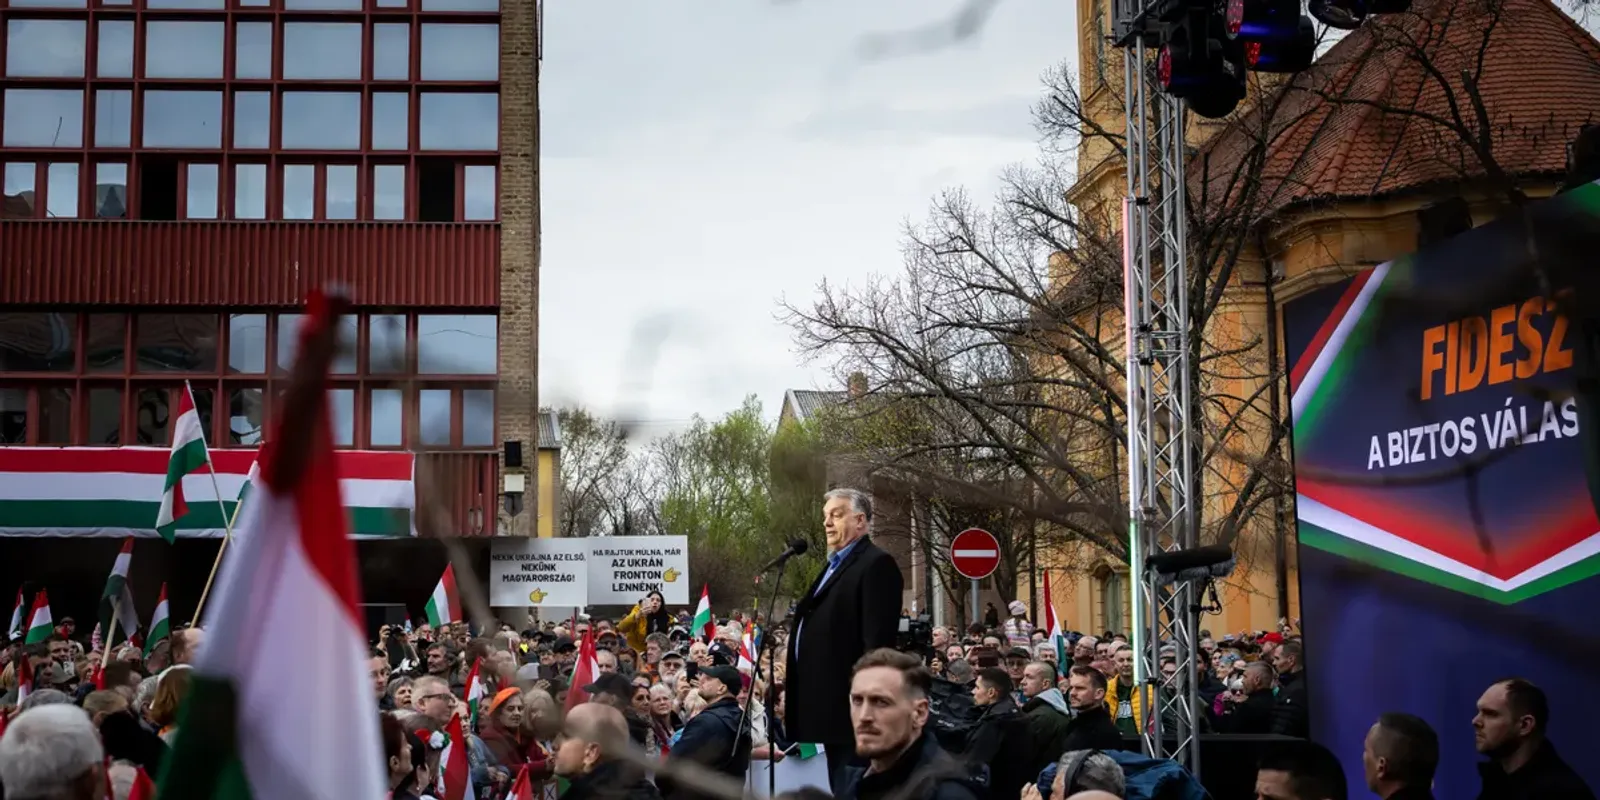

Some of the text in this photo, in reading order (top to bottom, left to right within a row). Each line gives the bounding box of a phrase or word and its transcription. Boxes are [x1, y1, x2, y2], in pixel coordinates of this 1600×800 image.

[1421, 288, 1574, 400] FIDESZ
[1367, 435, 1385, 470] A
[1388, 416, 1477, 467] BIZTOS
[515, 553, 552, 561] UKRAJNA
[553, 553, 564, 561] AZ
[635, 547, 664, 557] MÚLNA,
[664, 547, 682, 556] MÁR
[521, 562, 557, 572] NEKÜNK
[611, 557, 664, 568] AZ UKRÁN
[502, 572, 575, 583] MAGYARORSZÁG!
[613, 570, 662, 580] FRONTON
[612, 581, 664, 592] LENNÉNK!
